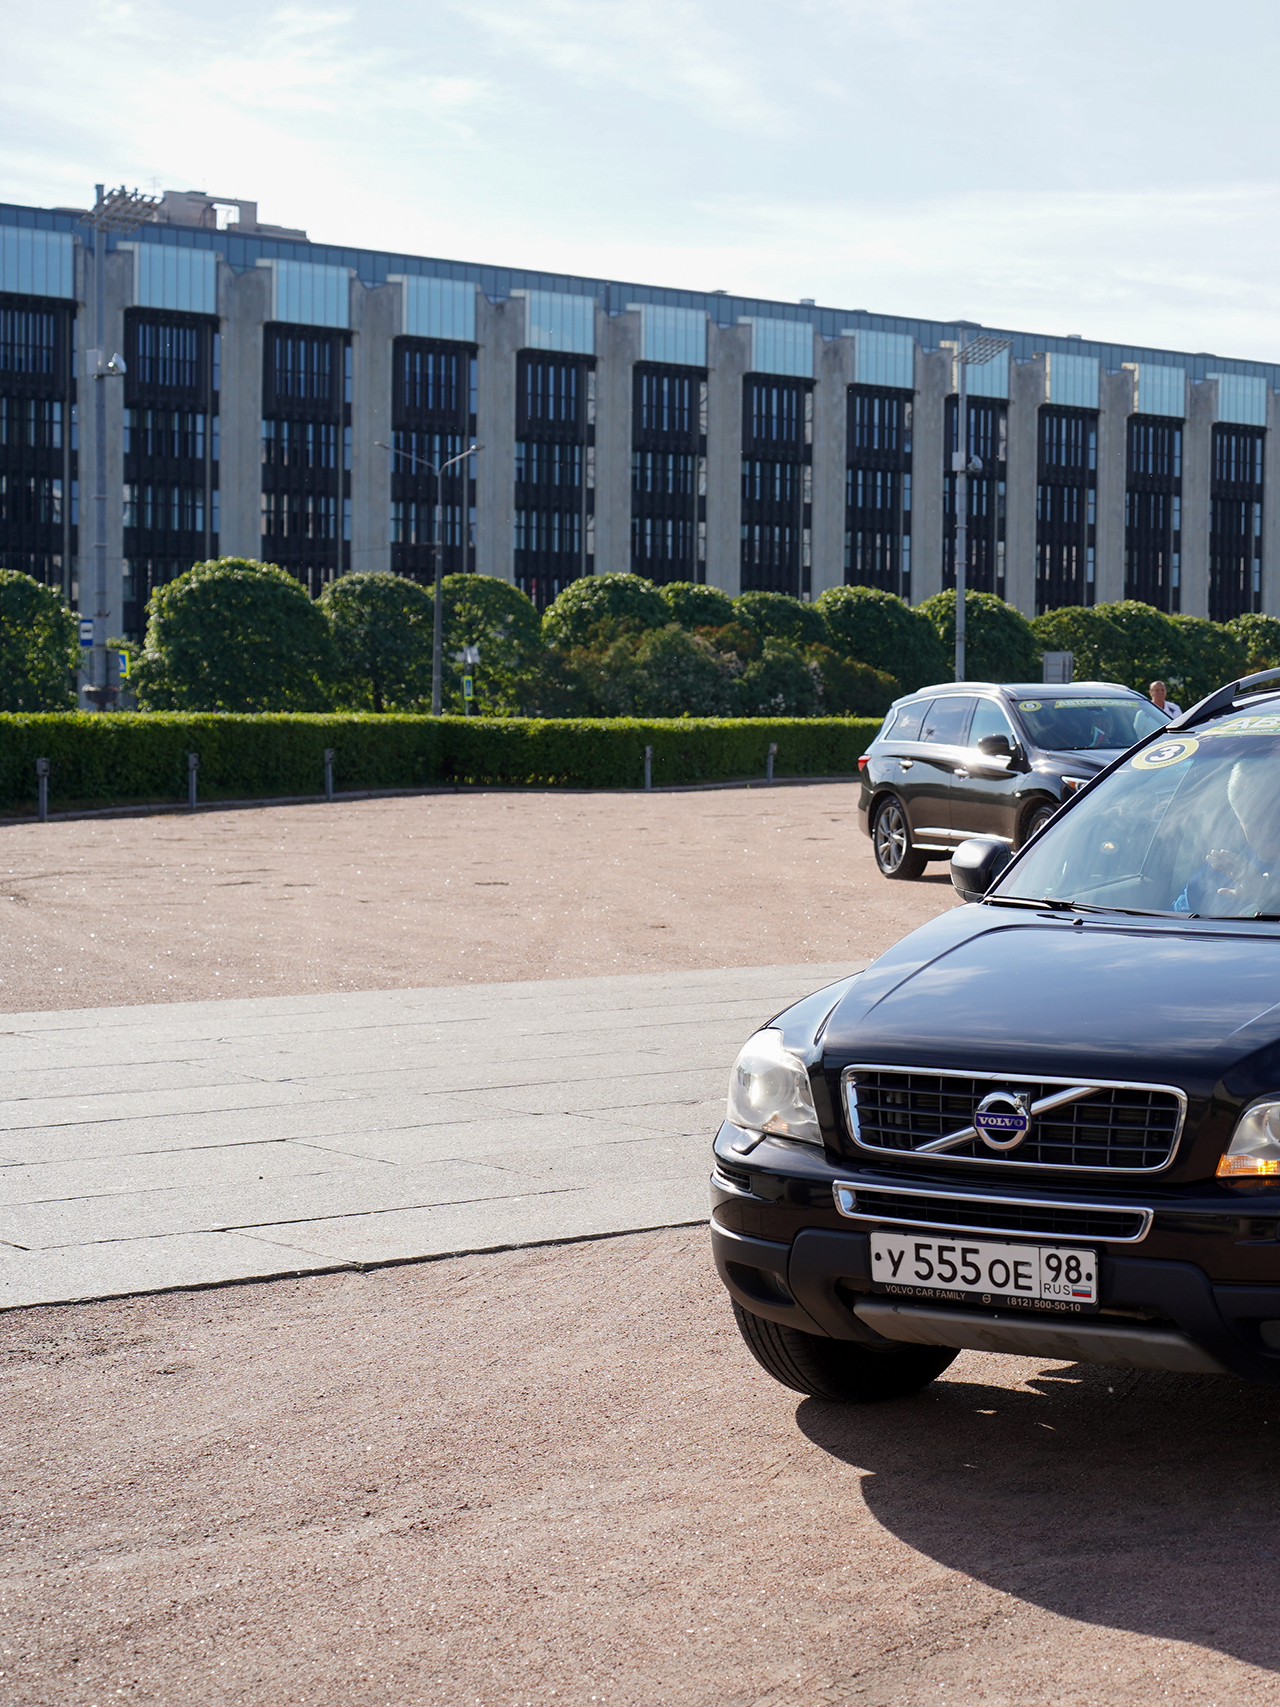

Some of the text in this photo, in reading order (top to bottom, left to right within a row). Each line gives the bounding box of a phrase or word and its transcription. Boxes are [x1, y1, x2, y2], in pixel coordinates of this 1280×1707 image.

[1058, 699, 1133, 707] АВТОПРОБЕГ
[1149, 745, 1181, 761] 3
[977, 1115, 1024, 1127] VOLVO
[1045, 1253, 1082, 1284] 98
[885, 1284, 966, 1301] VOLVO CAR FAMILY
[1043, 1283, 1071, 1295] RUS
[1006, 1296, 1081, 1312] (812) 500-50-10
